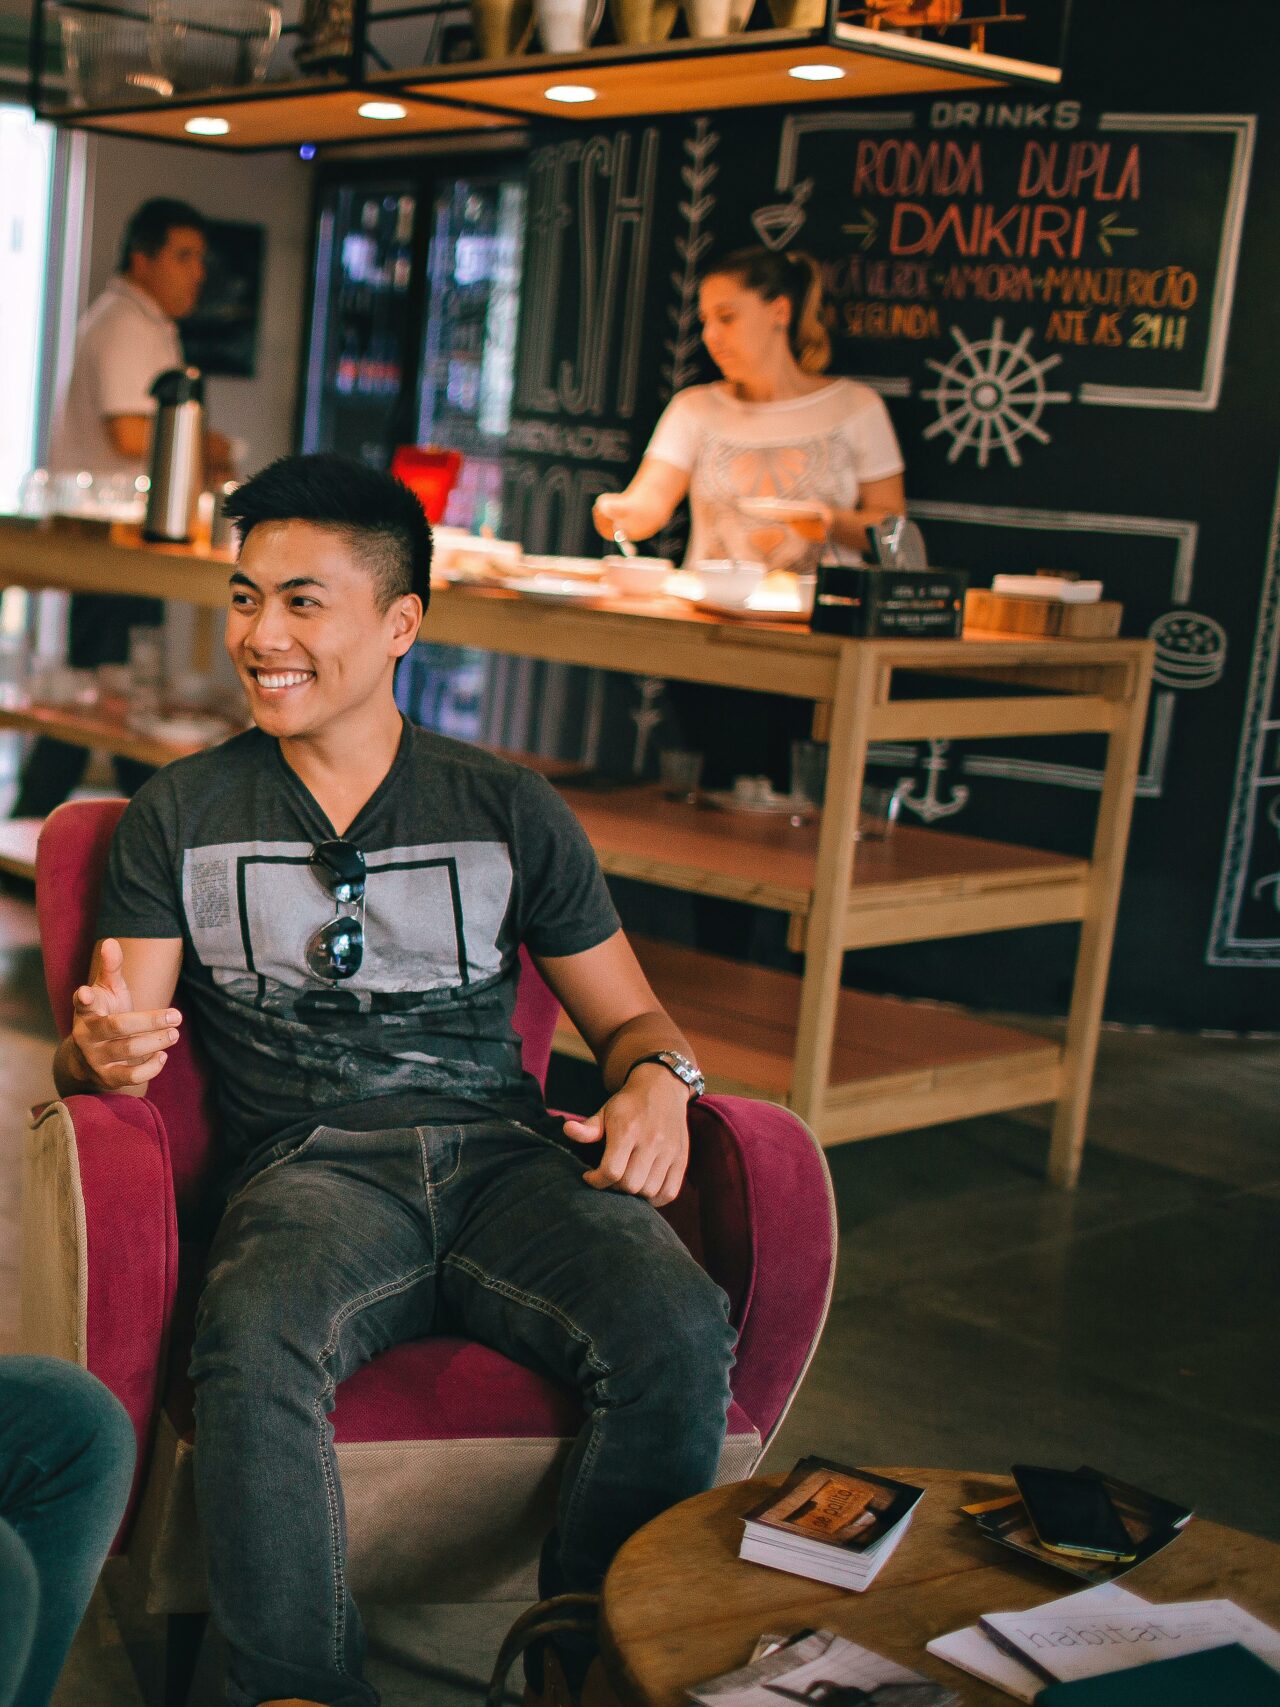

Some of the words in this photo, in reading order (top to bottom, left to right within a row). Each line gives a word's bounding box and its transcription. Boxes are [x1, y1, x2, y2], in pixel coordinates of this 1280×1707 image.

[931, 101, 1081, 129] DRINKS
[854, 140, 983, 197] RODADA
[1018, 141, 1140, 200] DUPLA
[890, 203, 1087, 259] DAIKIRI
[944, 264, 1034, 301] AMORA
[1017, 1621, 1181, 1648] habitat
